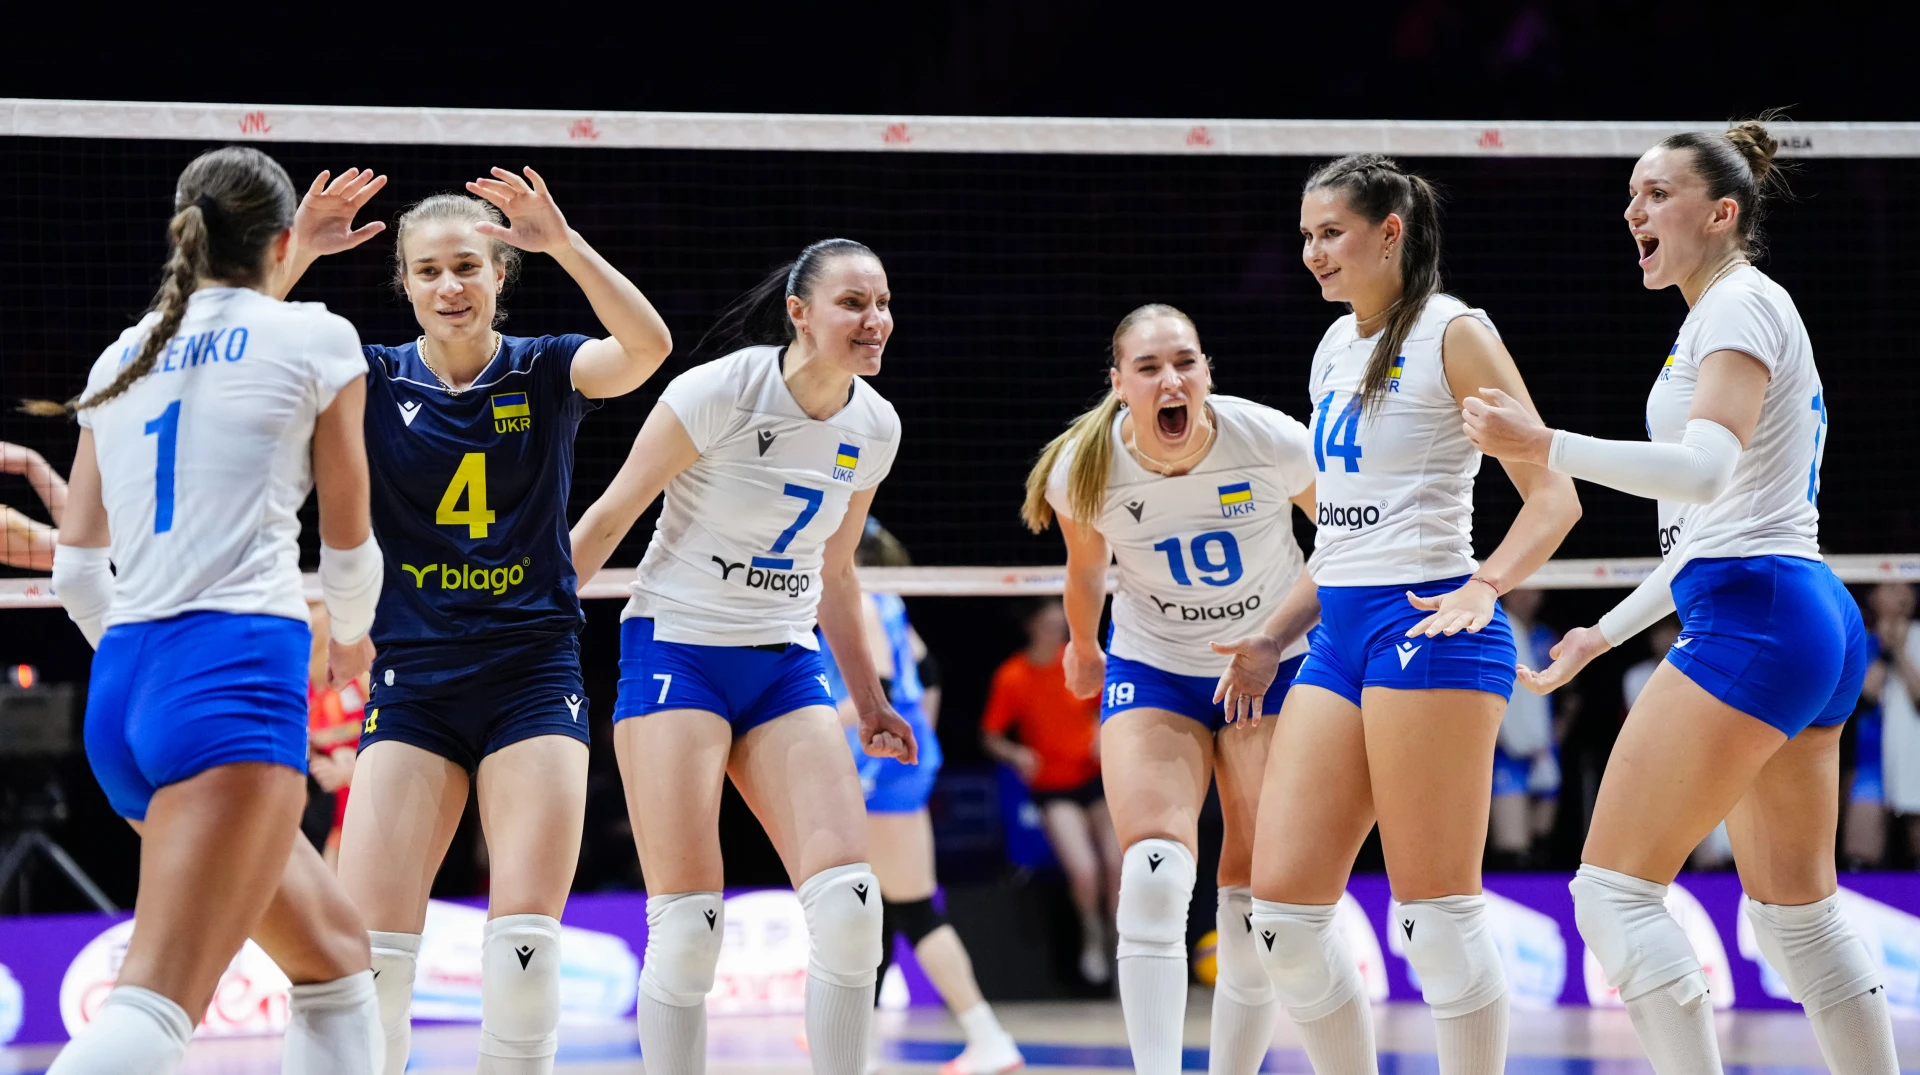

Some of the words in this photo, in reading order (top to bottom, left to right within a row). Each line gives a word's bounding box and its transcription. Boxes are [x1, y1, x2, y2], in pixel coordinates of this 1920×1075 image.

[238, 110, 272, 134] VNL
[494, 417, 531, 434] UKR
[1314, 391, 1363, 473] 14
[144, 399, 182, 535] 1
[832, 466, 855, 483] UKR
[435, 452, 496, 540] 4
[1221, 501, 1256, 519] UKR
[751, 482, 824, 571] 7
[1153, 530, 1244, 587] 19
[652, 673, 672, 704] 7
[1107, 681, 1135, 709] 19
[364, 708, 379, 734] 4
